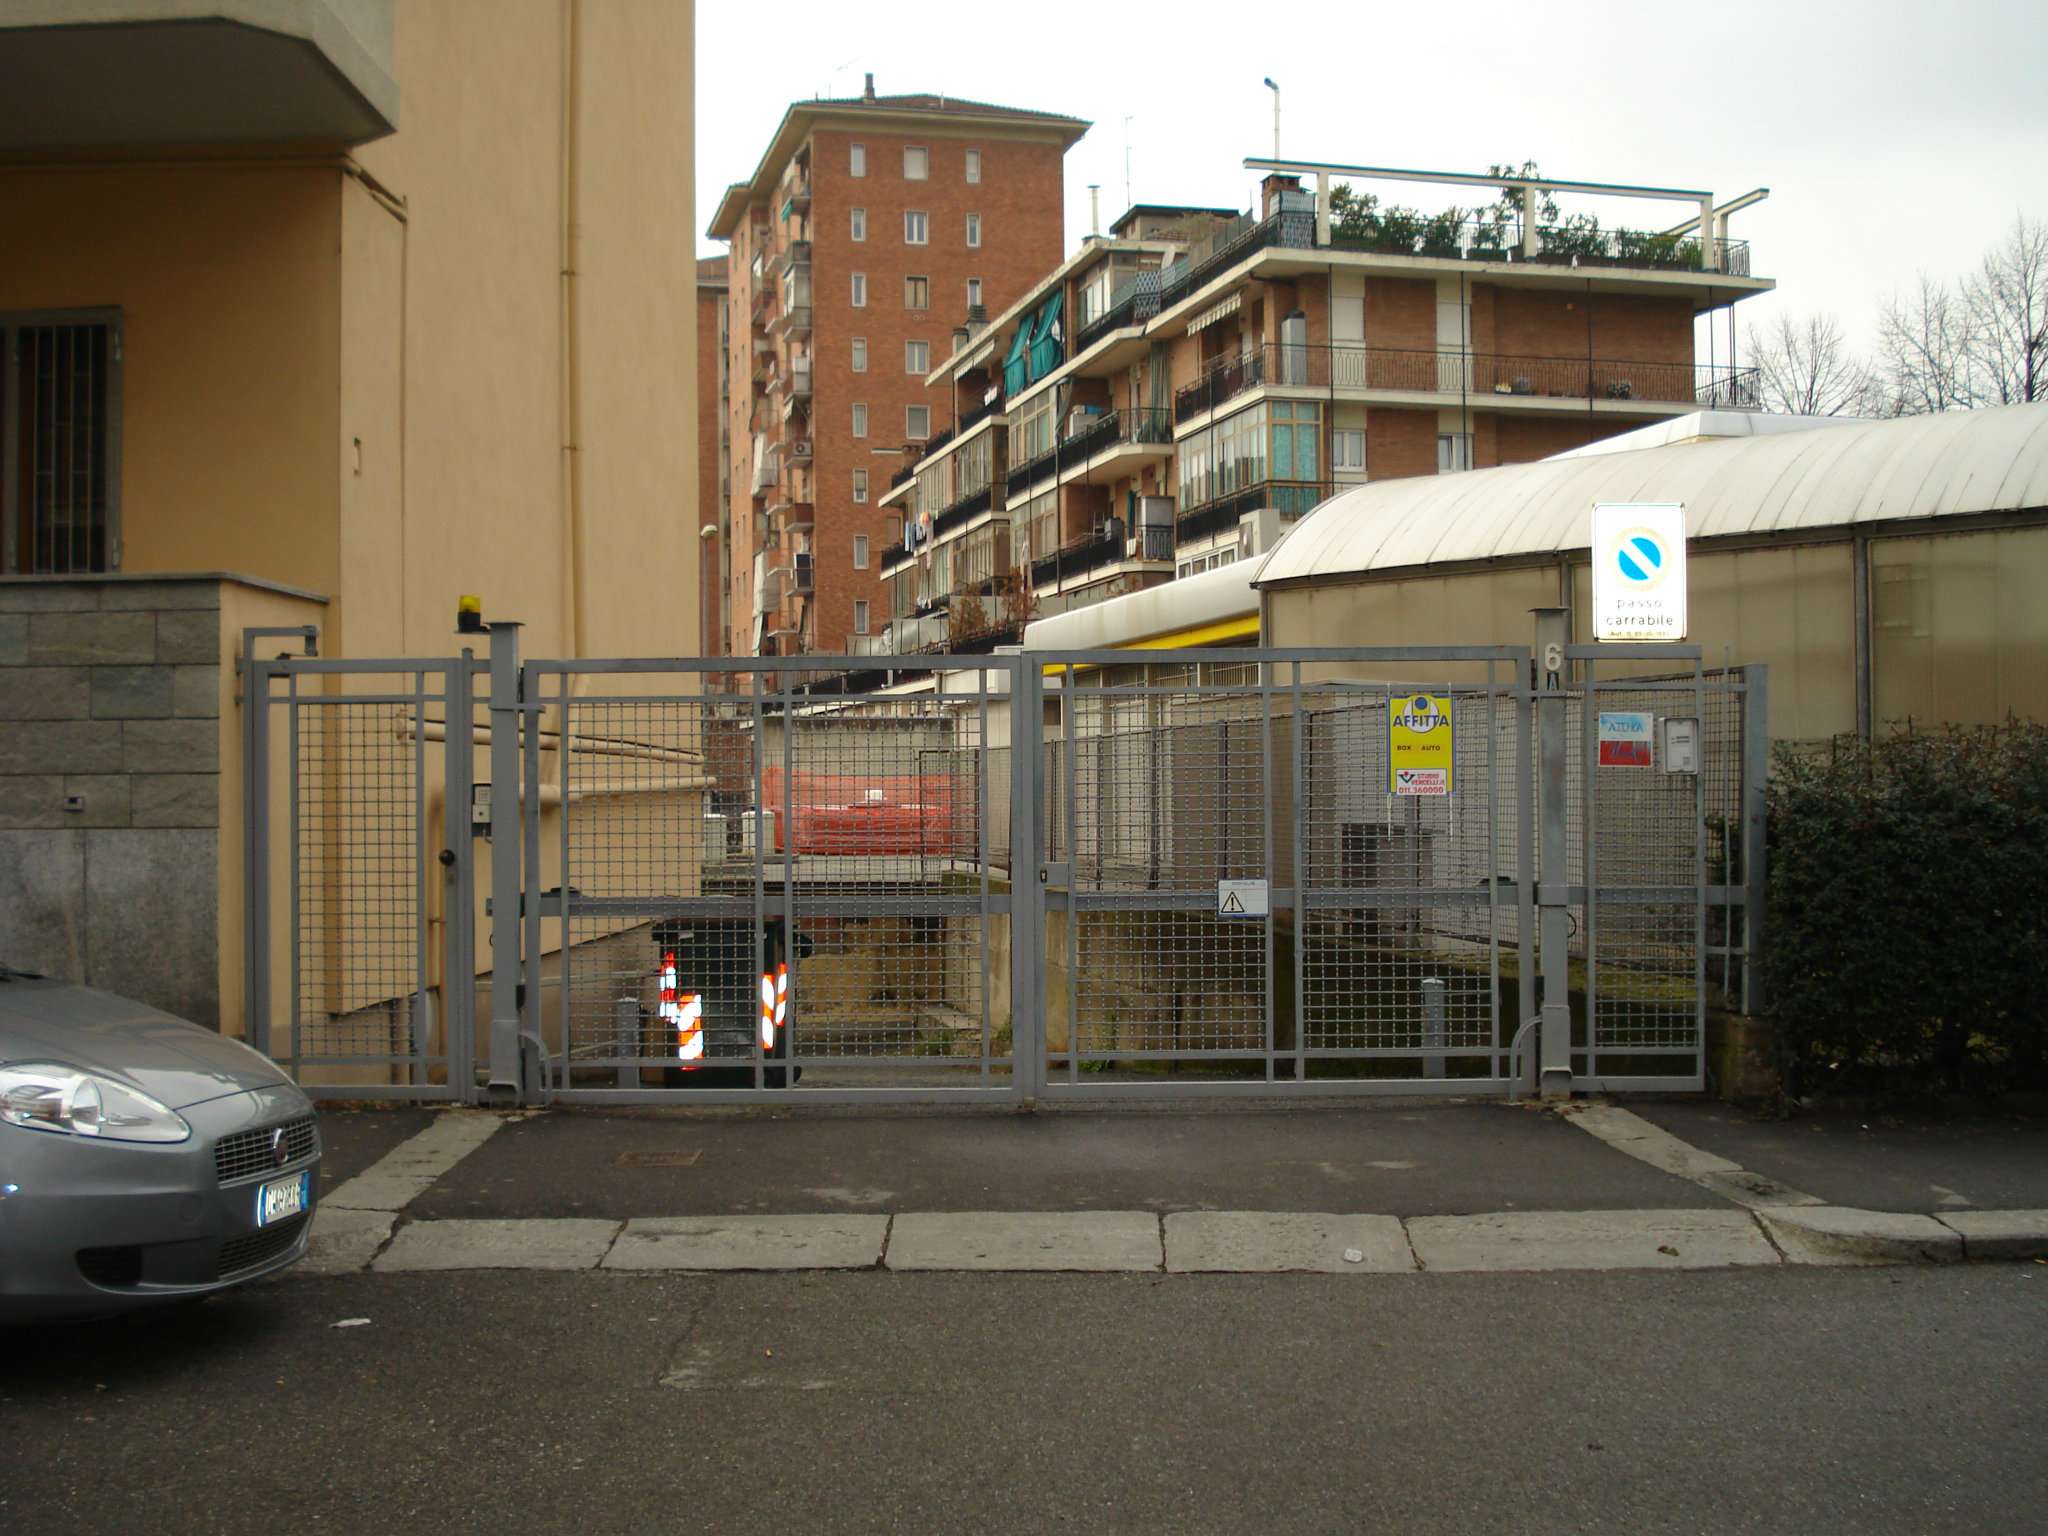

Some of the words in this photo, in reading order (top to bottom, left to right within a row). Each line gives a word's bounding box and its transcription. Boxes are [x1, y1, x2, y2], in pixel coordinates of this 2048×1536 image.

[1617, 599, 1662, 609] passo
[1606, 614, 1673, 626] carrabile
[1544, 643, 1561, 671] 6
[1547, 672, 1560, 690] A
[1392, 715, 1449, 727] AFFITTA
